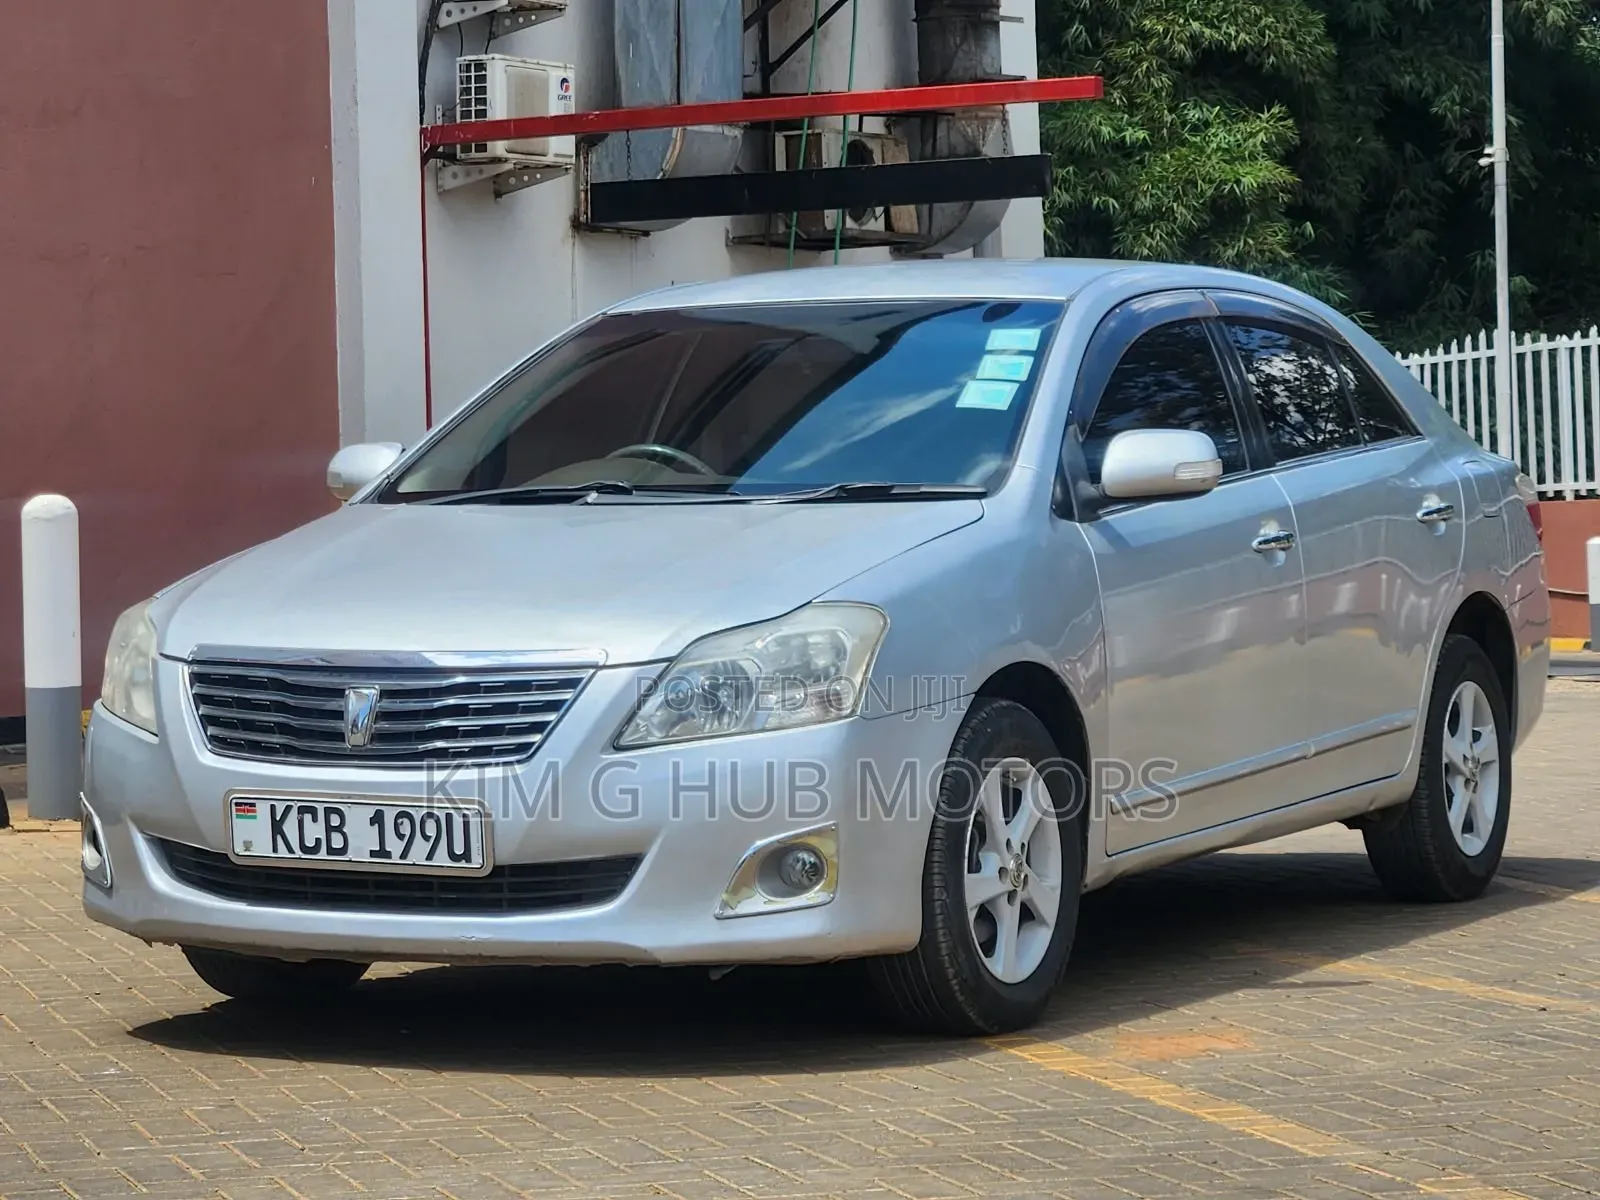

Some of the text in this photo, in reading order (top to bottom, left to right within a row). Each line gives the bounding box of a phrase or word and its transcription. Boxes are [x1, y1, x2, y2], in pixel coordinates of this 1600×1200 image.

[557, 94, 572, 102] GREE
[270, 803, 349, 857] KCB
[369, 808, 472, 864] 199U
